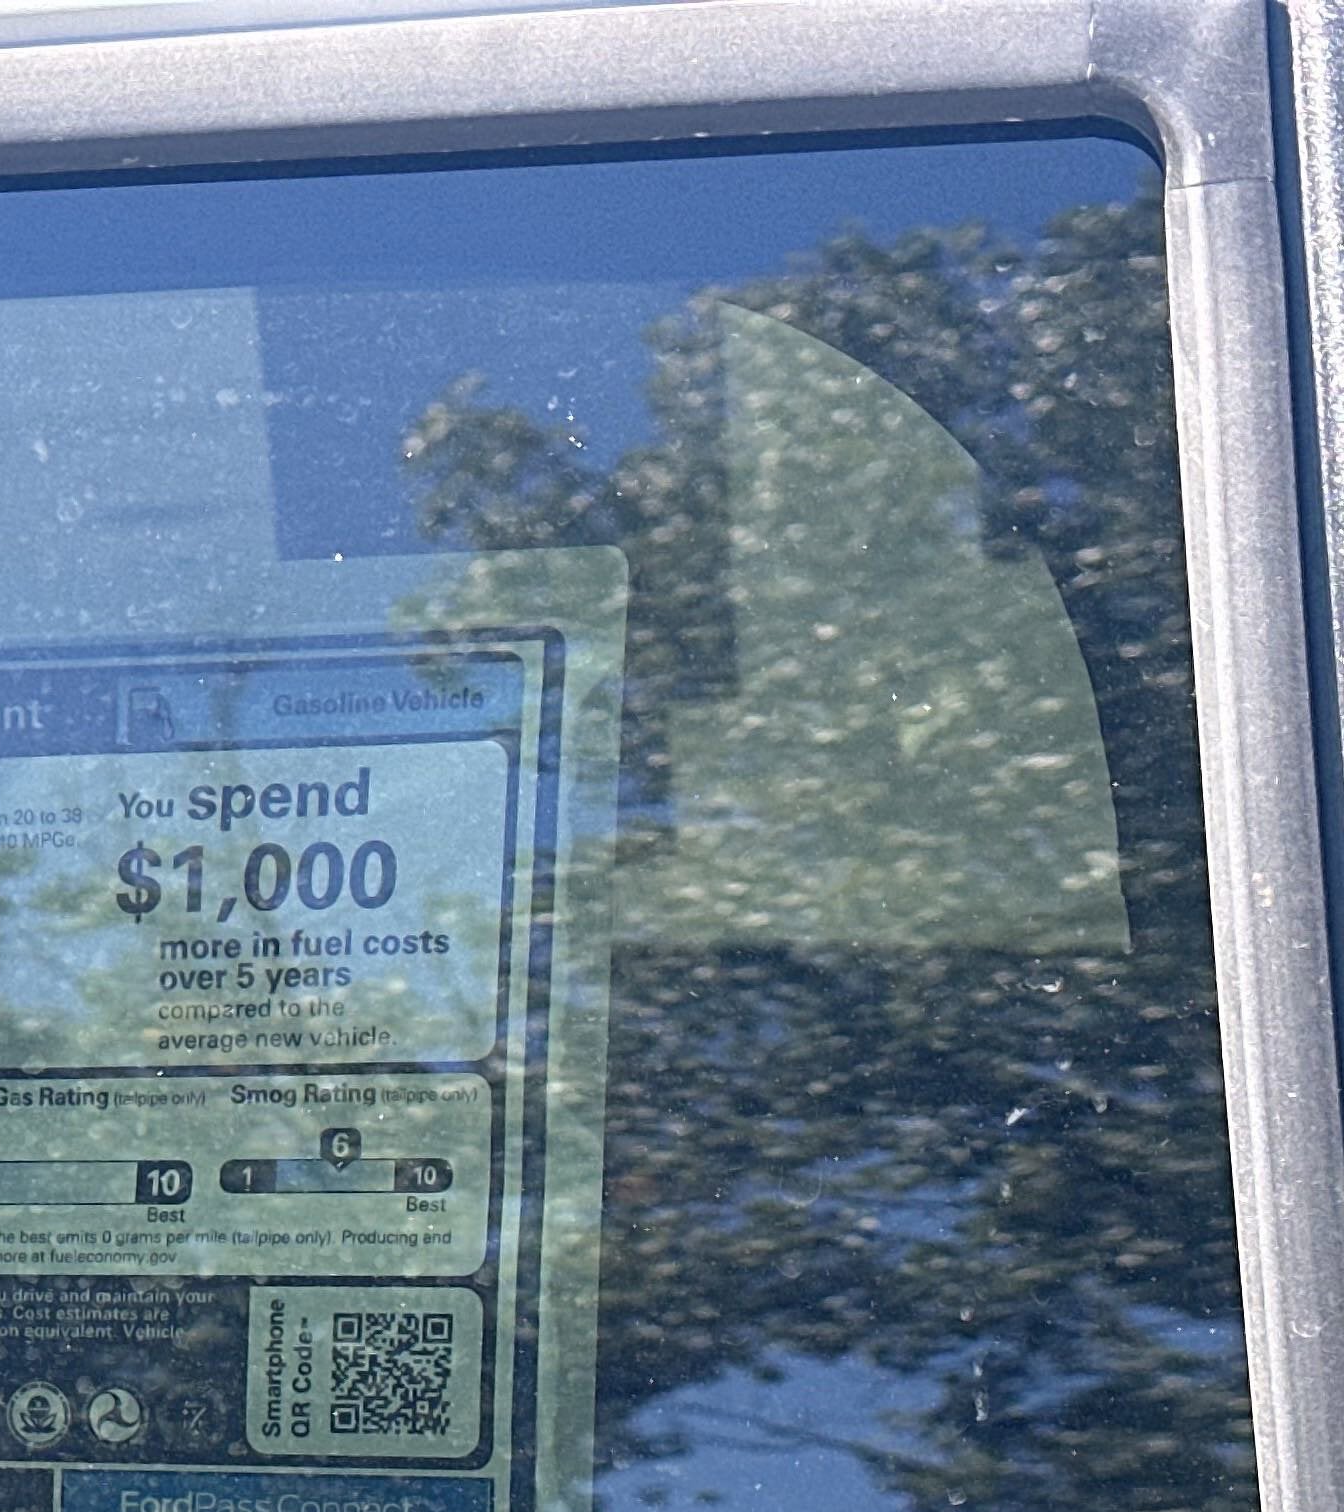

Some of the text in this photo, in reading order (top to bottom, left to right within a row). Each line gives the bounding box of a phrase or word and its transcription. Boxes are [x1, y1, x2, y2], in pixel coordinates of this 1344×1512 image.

[273, 689, 484, 717] Gasoline Vehicle
[119, 768, 370, 831] You spend
[115, 840, 398, 924] $1,000
[159, 931, 450, 959] more in fuel costs
[159, 964, 352, 994] over 5 years
[158, 999, 345, 1023] compared to the
[158, 1027, 398, 1053] average new vehicle.
[38, 1086, 109, 1112] Rating
[230, 1084, 377, 1109] Smog Rating
[332, 1134, 348, 1156] 6
[147, 1170, 180, 1196] 10
[244, 1167, 436, 1185] 1 10
[147, 1206, 185, 1223] Best
[406, 1197, 446, 1213] Best
[263, 1298, 285, 1438] Smartphone
[294, 1402, 314, 1438] QR
